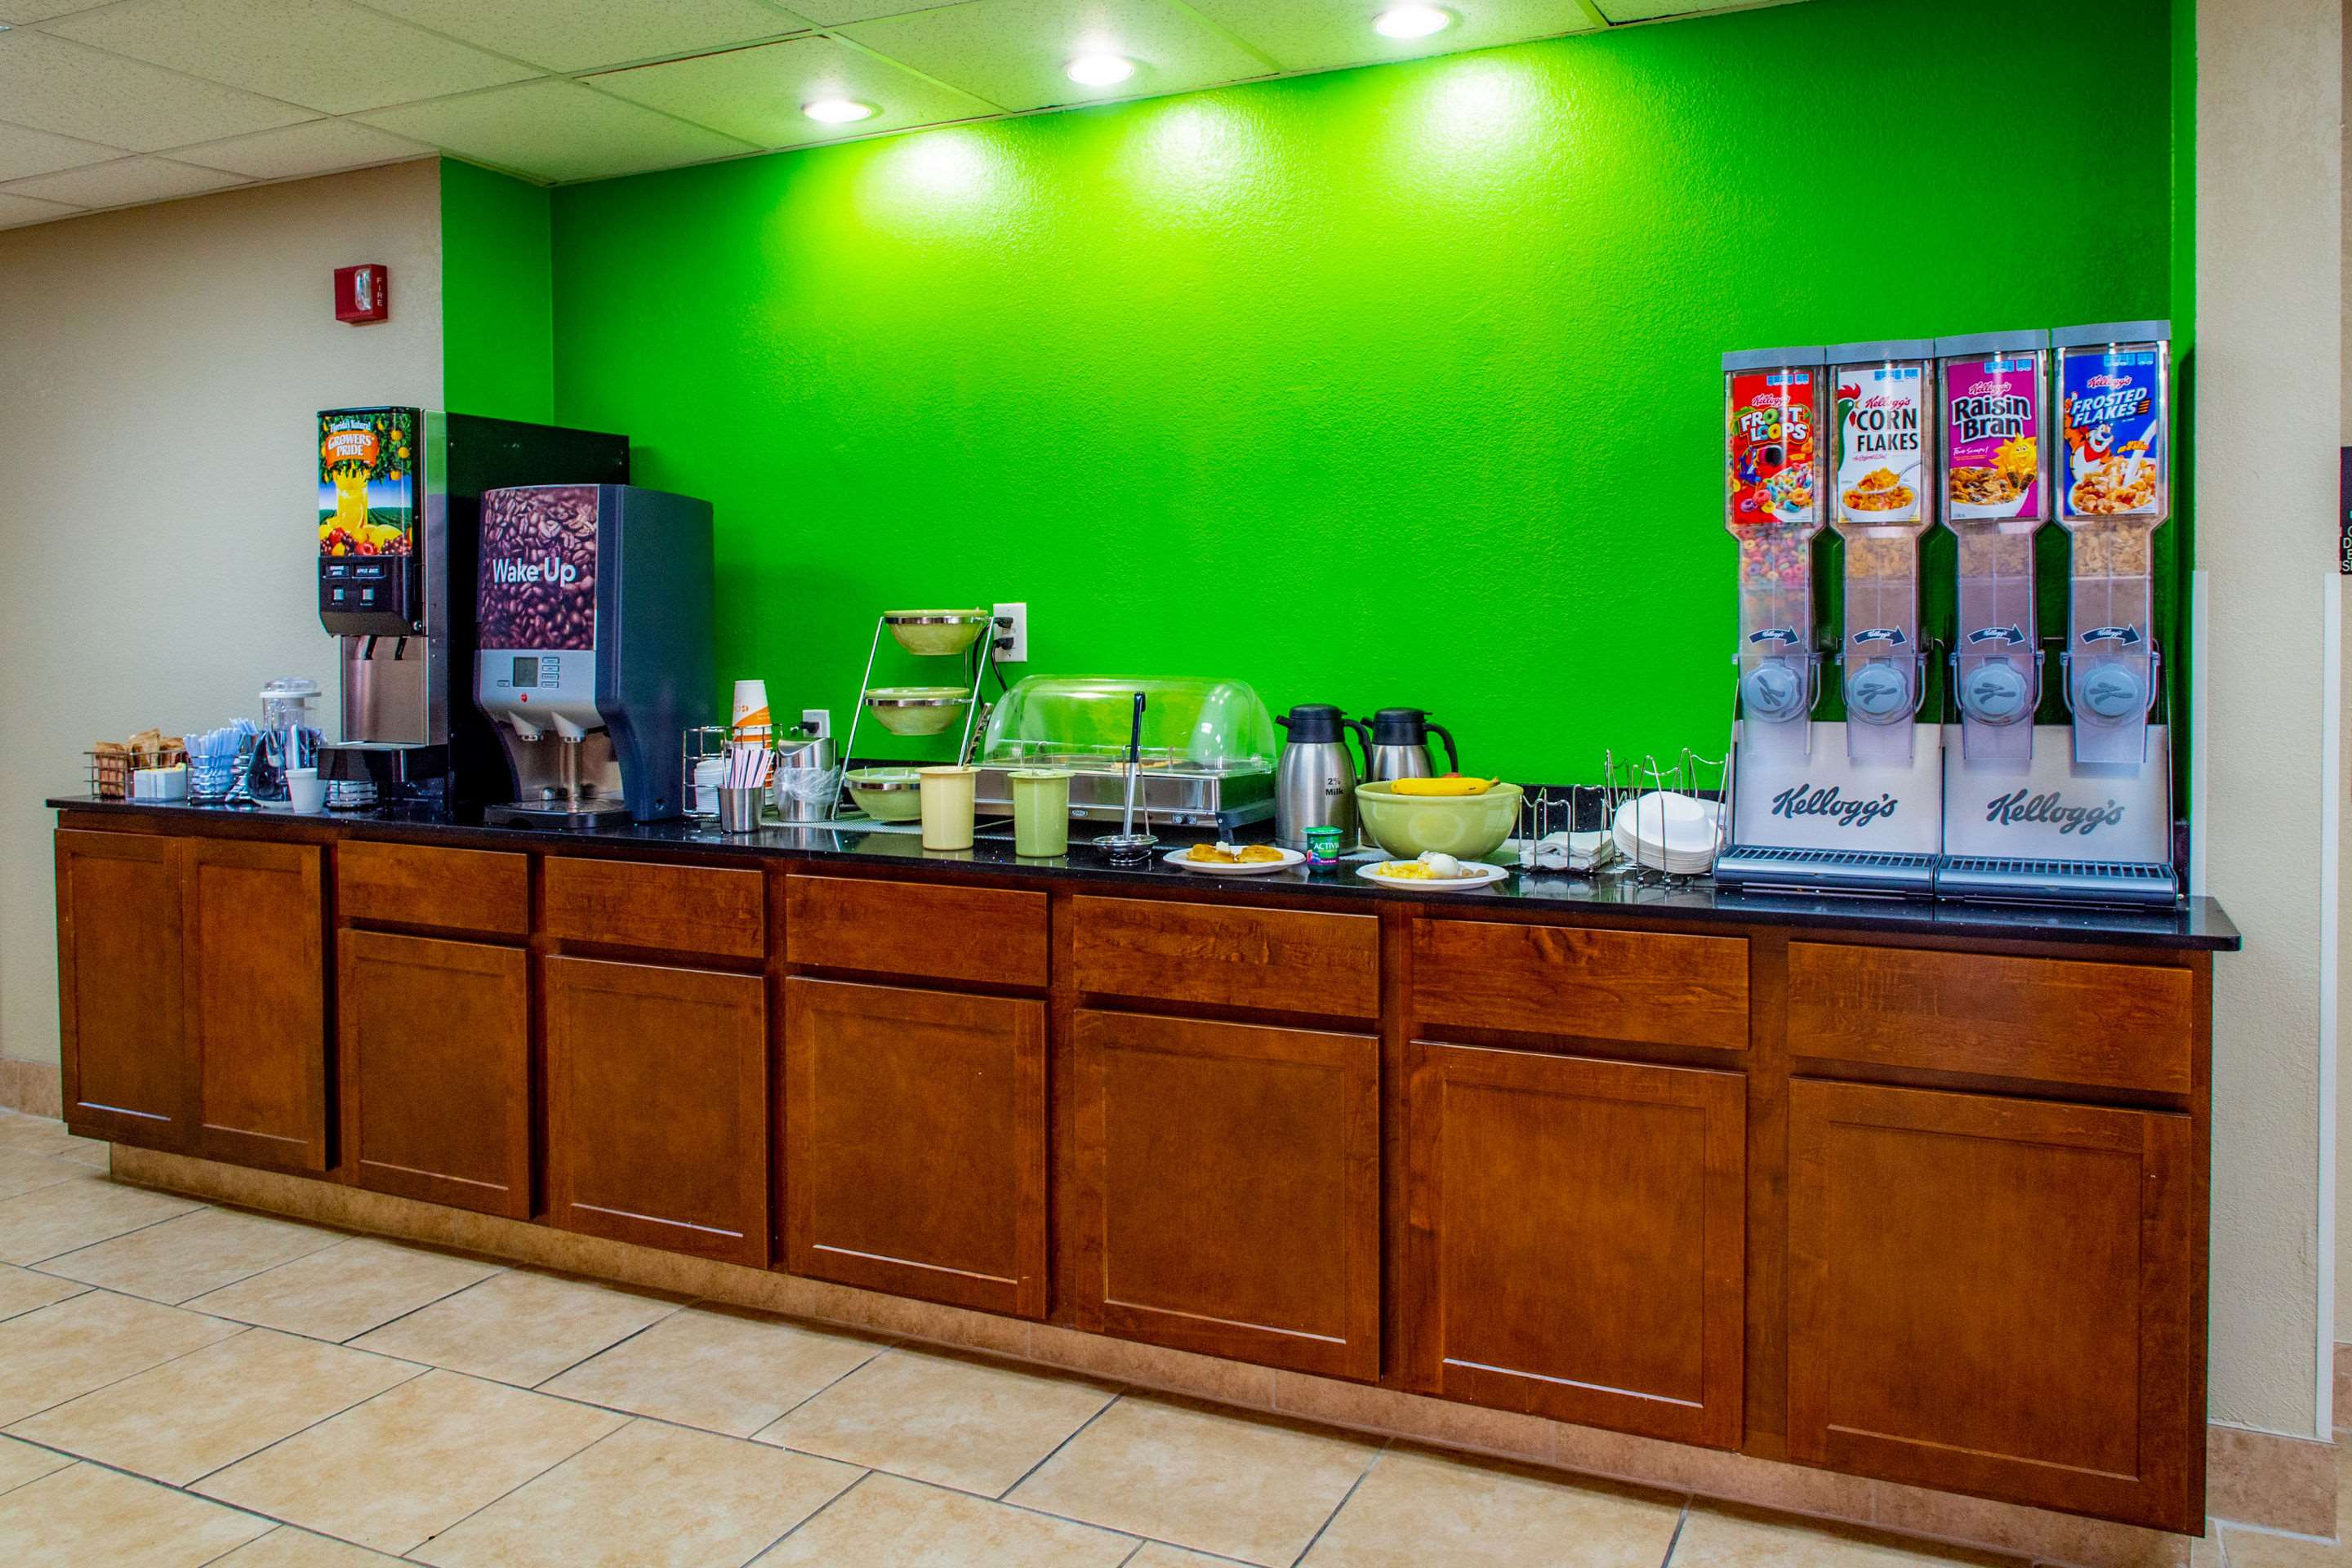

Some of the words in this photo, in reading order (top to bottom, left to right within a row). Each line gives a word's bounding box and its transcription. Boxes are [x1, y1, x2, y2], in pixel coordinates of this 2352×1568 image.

[1865, 395, 1911, 409] Kellgg's
[1953, 395, 2030, 424] Raisin
[2071, 387, 2147, 416] FROSTED
[1740, 407, 1803, 432] FROT
[1856, 408, 1917, 431] CORN
[2073, 402, 2138, 428] FLAKES
[1750, 422, 1808, 442] LOOPS
[1962, 416, 2022, 442] Bran
[336, 444, 364, 457] PRIDE
[1857, 433, 1918, 452] FLAKES
[492, 557, 539, 583] Wake
[544, 556, 577, 588] Up
[1771, 783, 1899, 827] Kellogg's
[1986, 788, 2126, 835] Kellogg's
